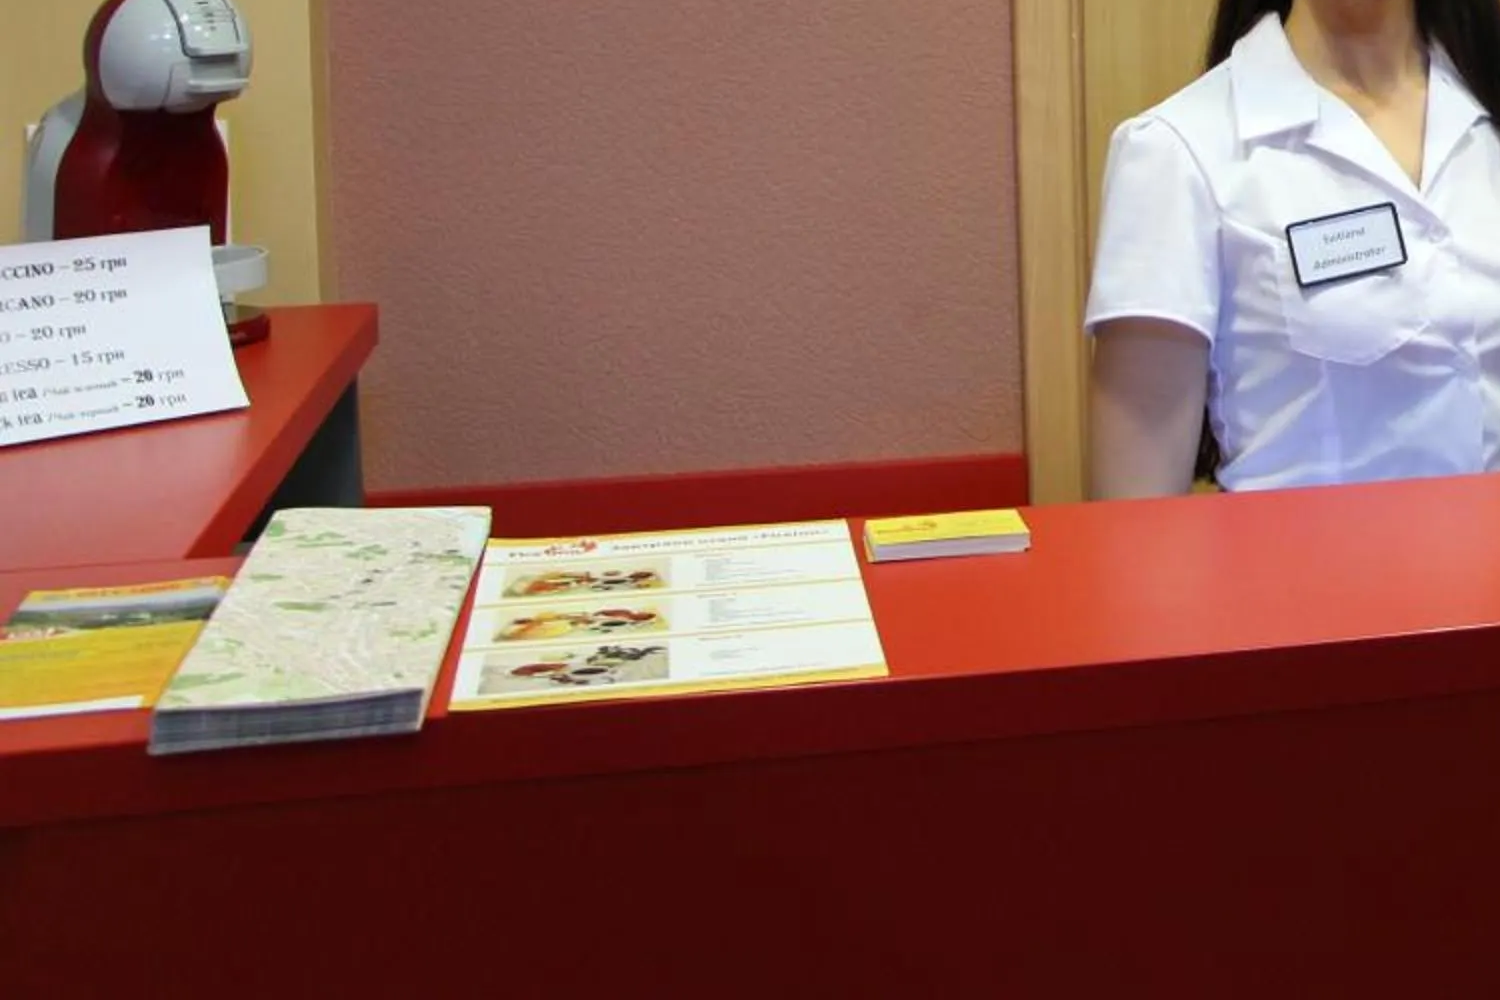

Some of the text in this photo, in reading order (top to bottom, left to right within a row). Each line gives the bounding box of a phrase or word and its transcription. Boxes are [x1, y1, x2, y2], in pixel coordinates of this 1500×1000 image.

[0, 263, 55, 281] CCINO
[73, 257, 96, 273] 25
[74, 289, 96, 305] 20
[31, 325, 53, 341] 20
[0, 357, 51, 375] ESSO
[72, 350, 93, 366] 15
[133, 369, 153, 384] 20
[136, 394, 155, 409] 20
